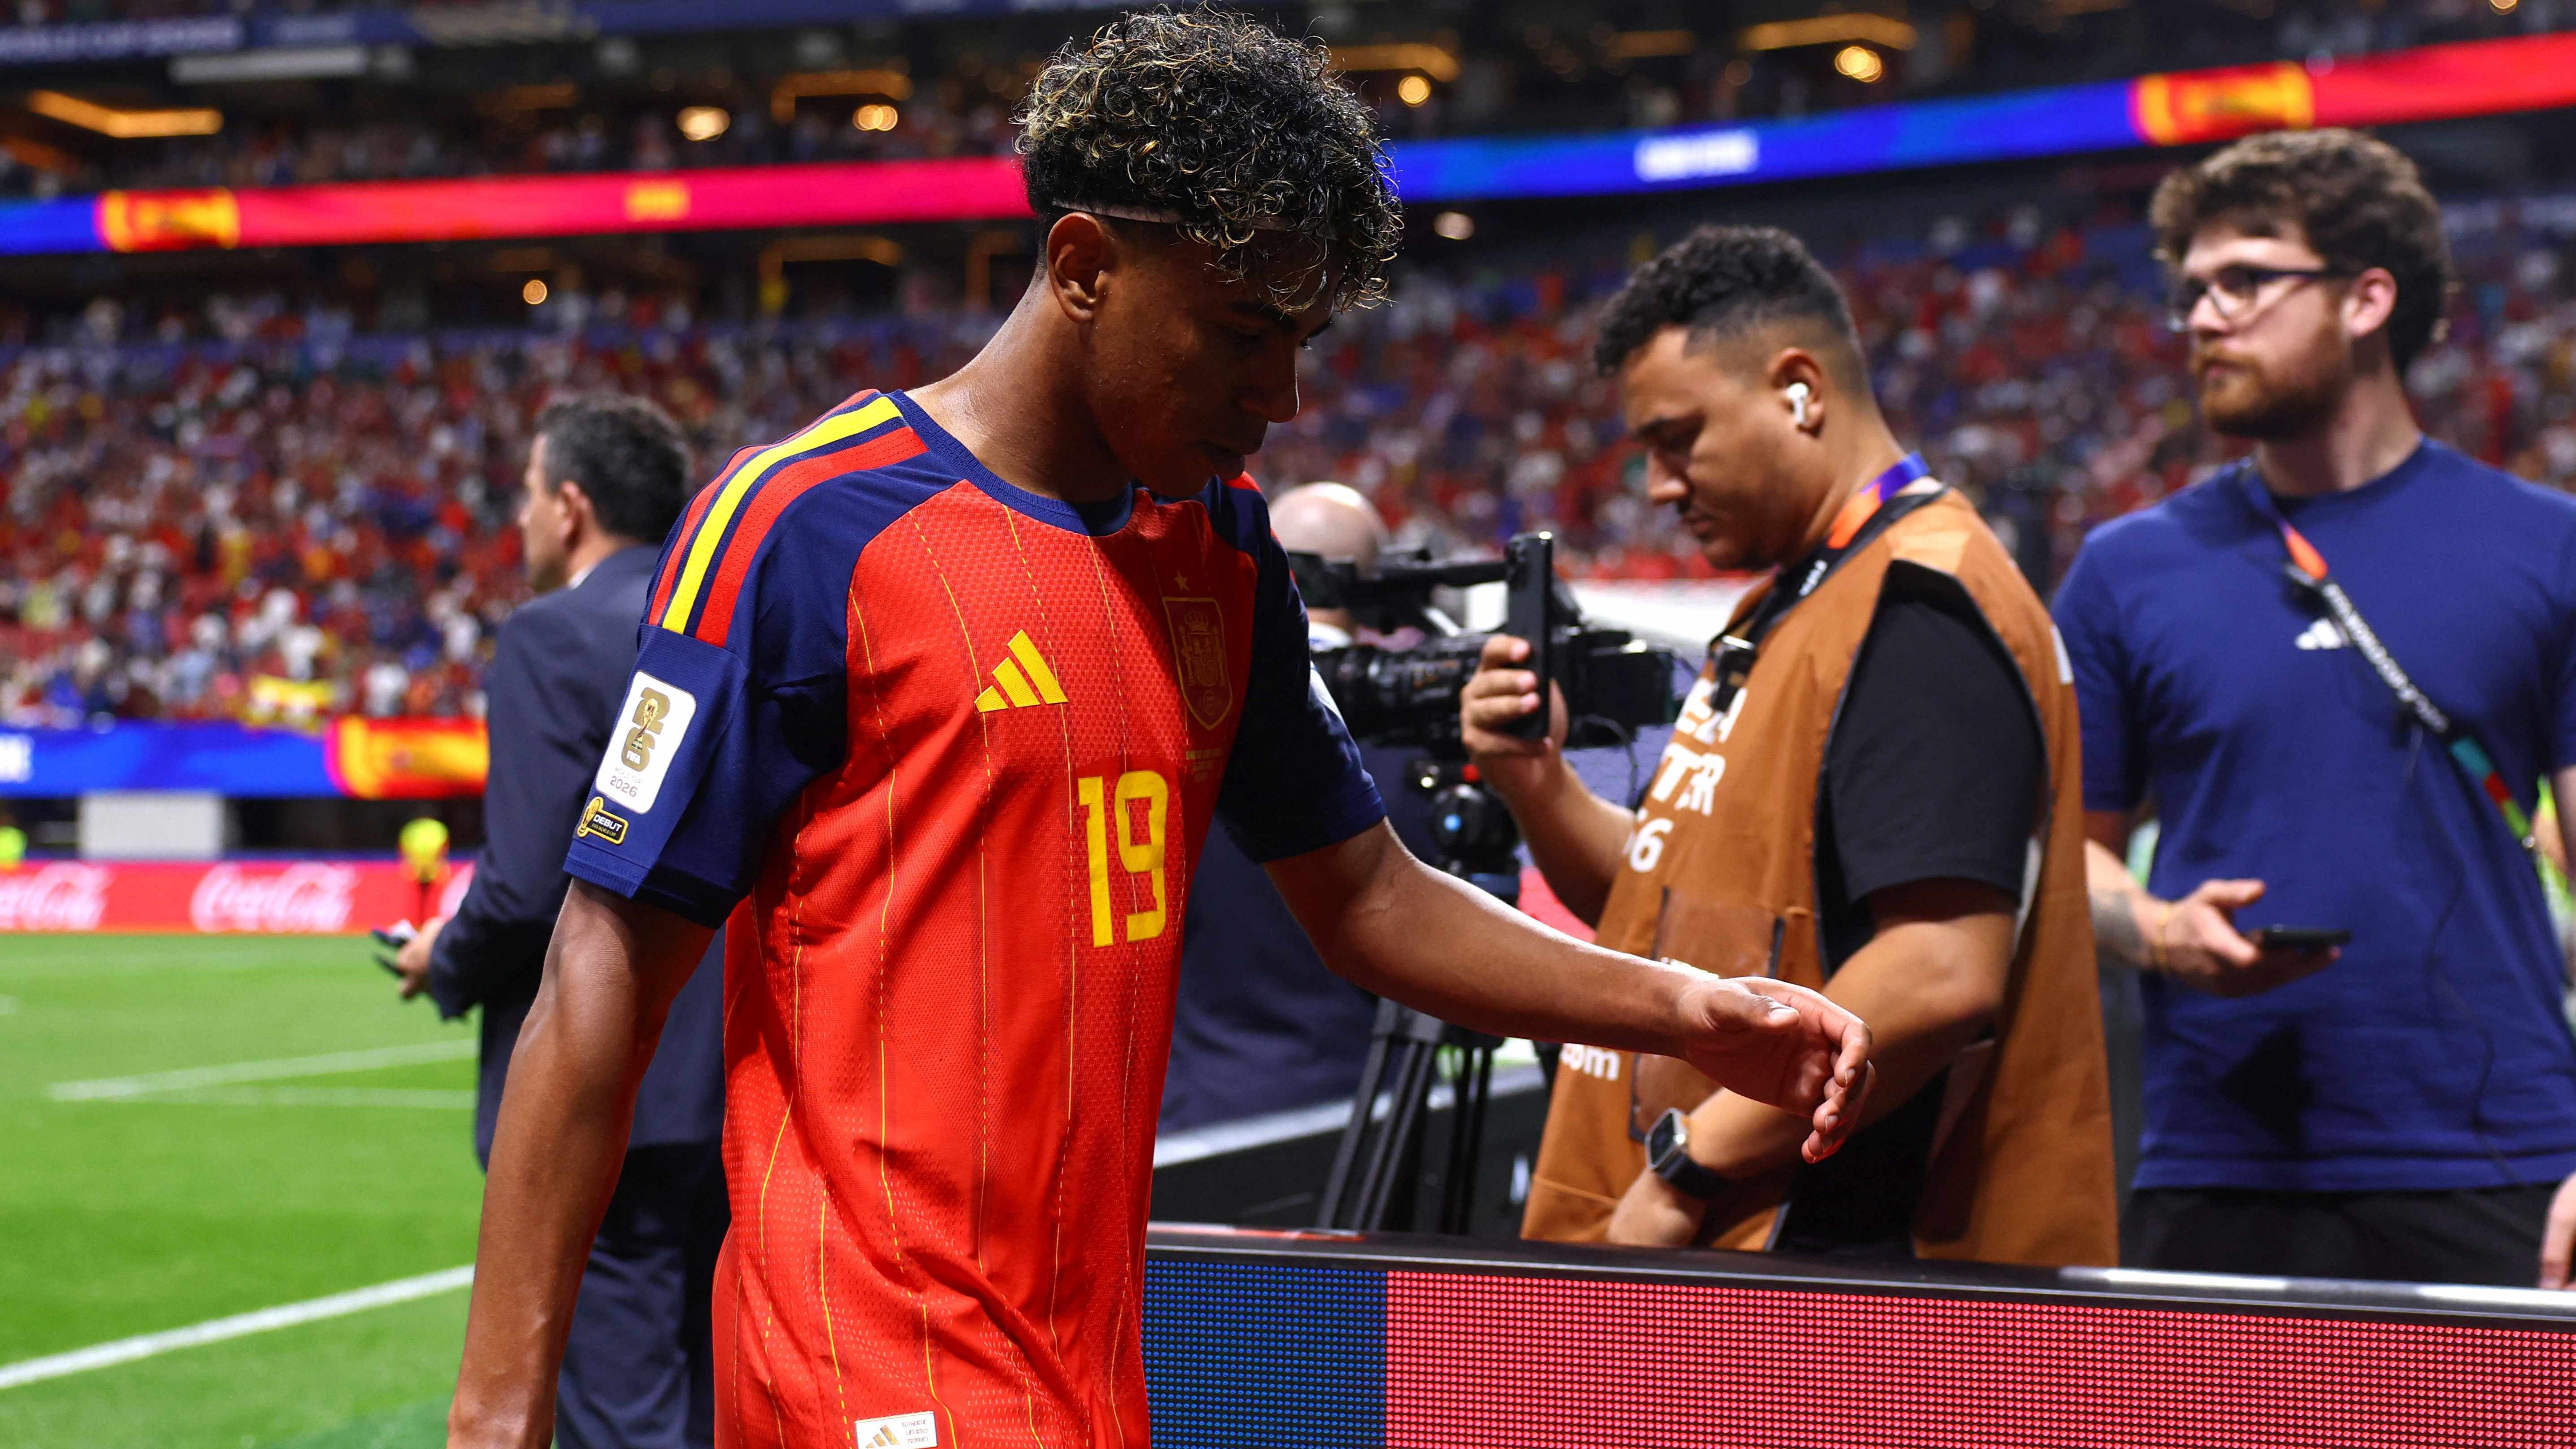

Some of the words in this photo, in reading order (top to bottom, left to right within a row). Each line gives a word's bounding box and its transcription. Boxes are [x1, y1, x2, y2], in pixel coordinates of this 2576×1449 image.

[610, 775, 638, 797] 2026
[593, 814, 623, 832] DEBUT
[1078, 770, 1168, 948] 19
